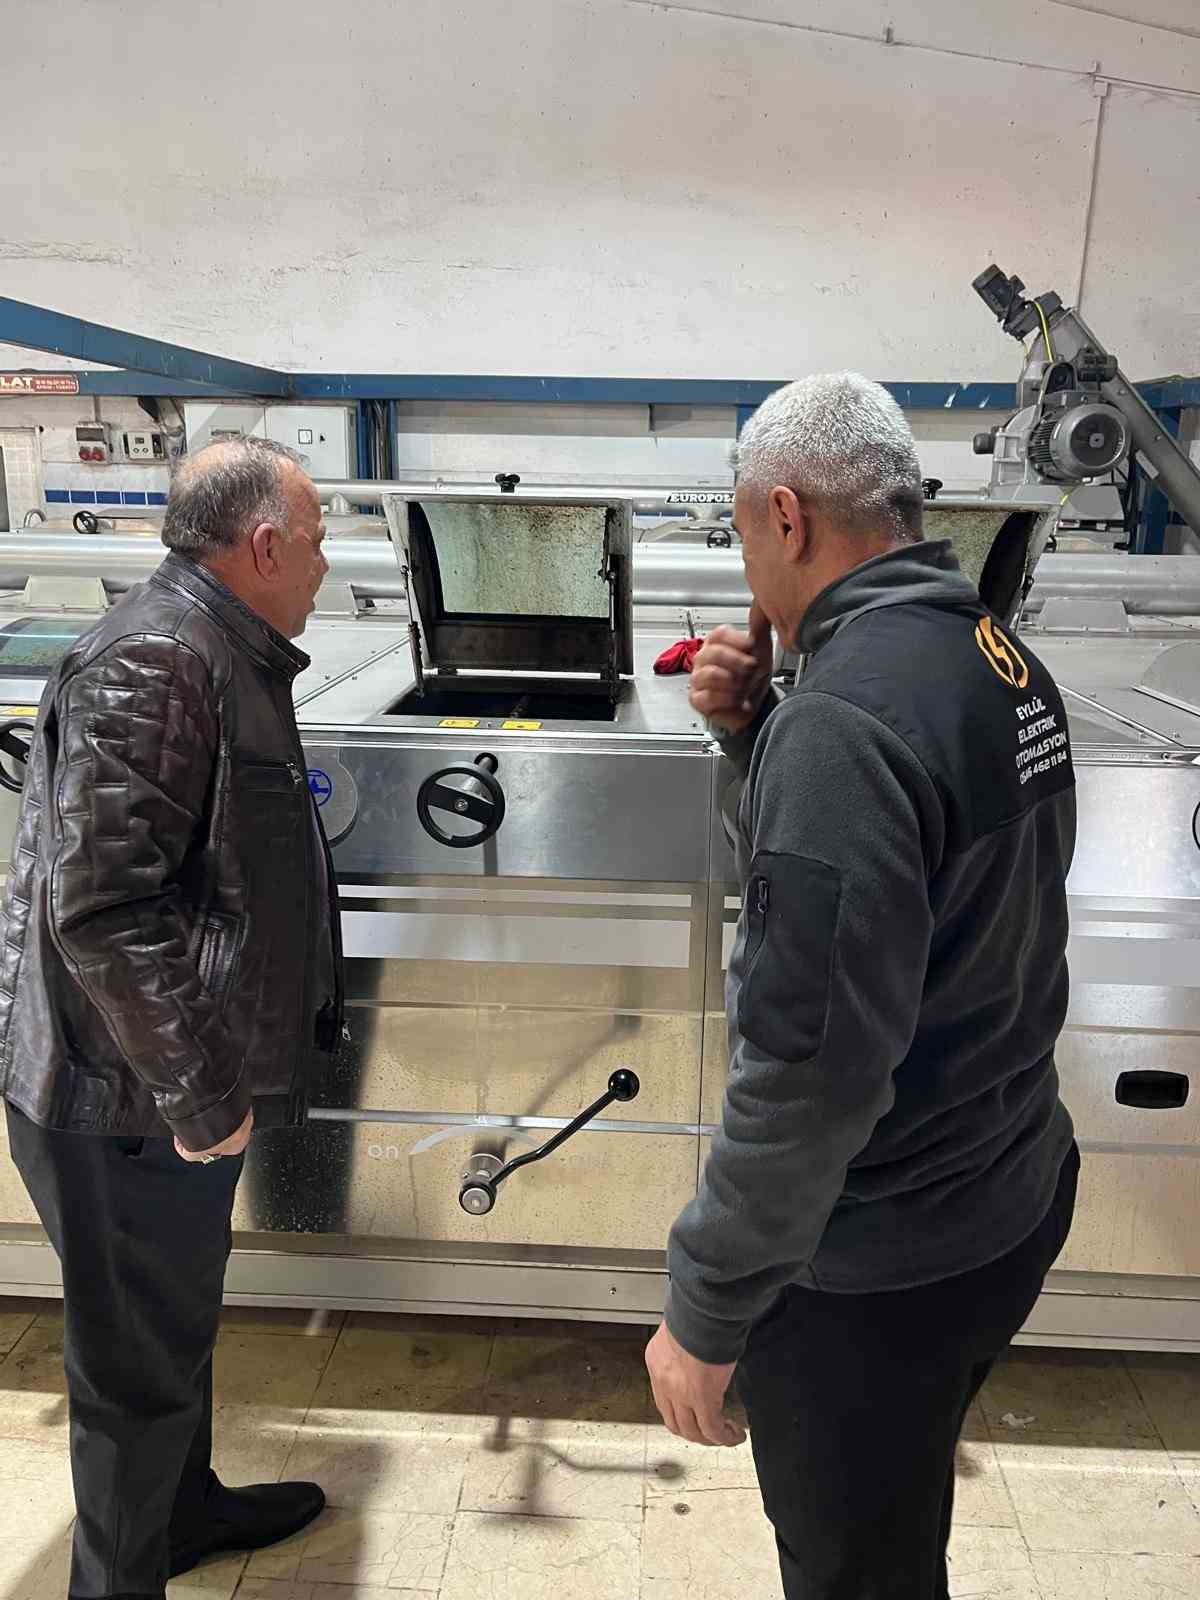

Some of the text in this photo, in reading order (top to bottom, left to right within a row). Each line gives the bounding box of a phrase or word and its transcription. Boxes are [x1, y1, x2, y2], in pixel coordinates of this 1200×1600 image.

[1016, 696, 1046, 721] EYLÜL
[1015, 731, 1067, 769] OTOMASYON
[367, 1144, 399, 1160] on
